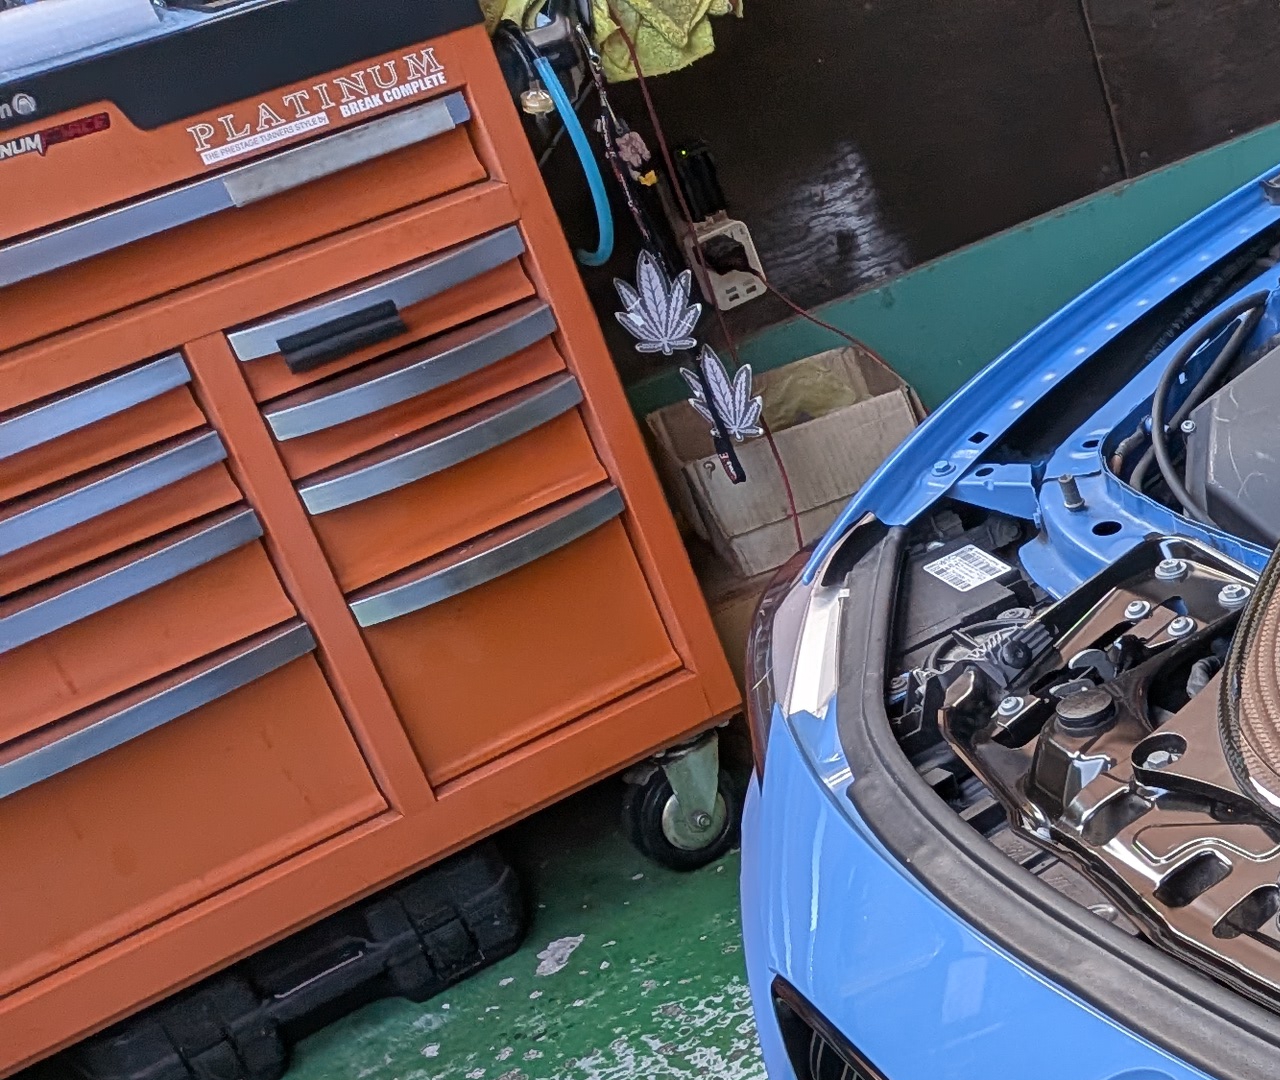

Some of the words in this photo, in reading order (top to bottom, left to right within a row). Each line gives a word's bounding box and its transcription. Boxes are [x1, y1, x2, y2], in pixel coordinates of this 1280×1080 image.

[187, 48, 445, 151] PLATINUM
[339, 93, 382, 118] BREAK
[382, 71, 448, 104] COMPLETE
[203, 149, 220, 163] THE
[294, 117, 320, 135] STYLE
